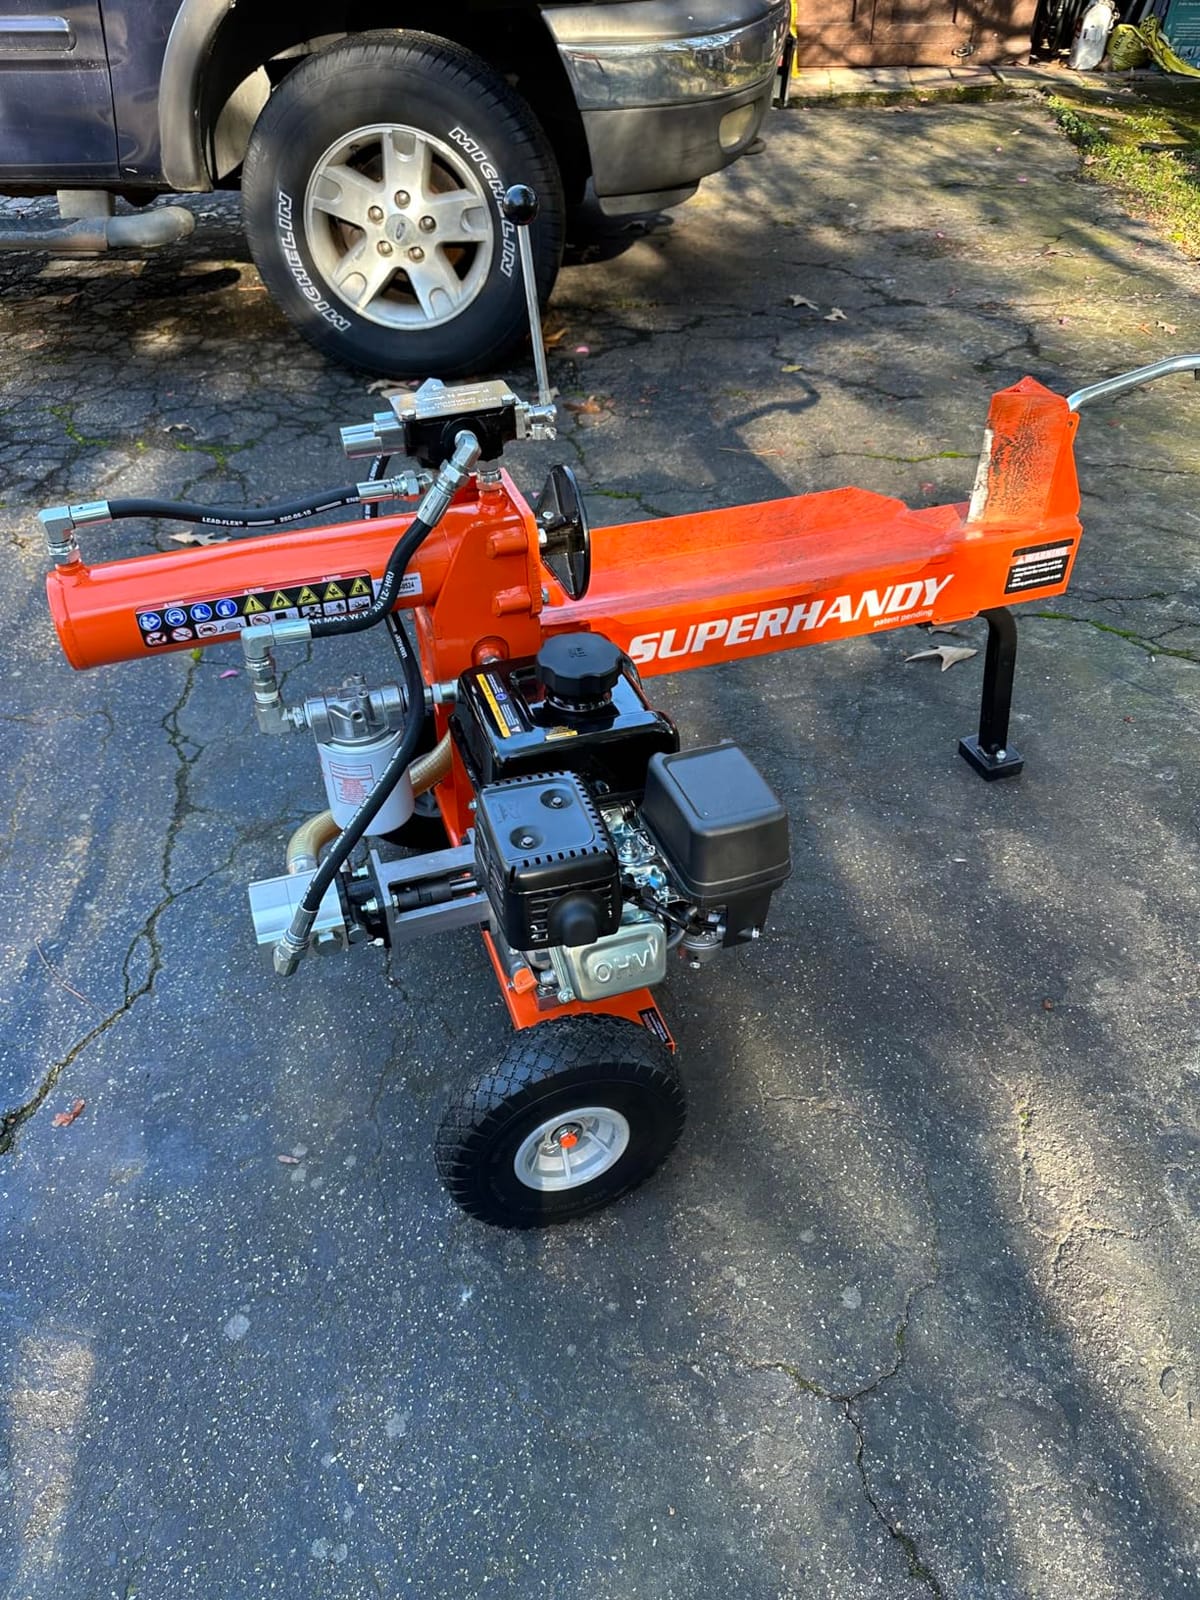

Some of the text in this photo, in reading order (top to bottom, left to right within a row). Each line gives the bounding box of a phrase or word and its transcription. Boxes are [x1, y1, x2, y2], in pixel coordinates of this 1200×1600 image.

[277, 191, 351, 332] MICHELIN
[628, 573, 955, 665] SUPERHANDY
[873, 608, 934, 628] patent pending
